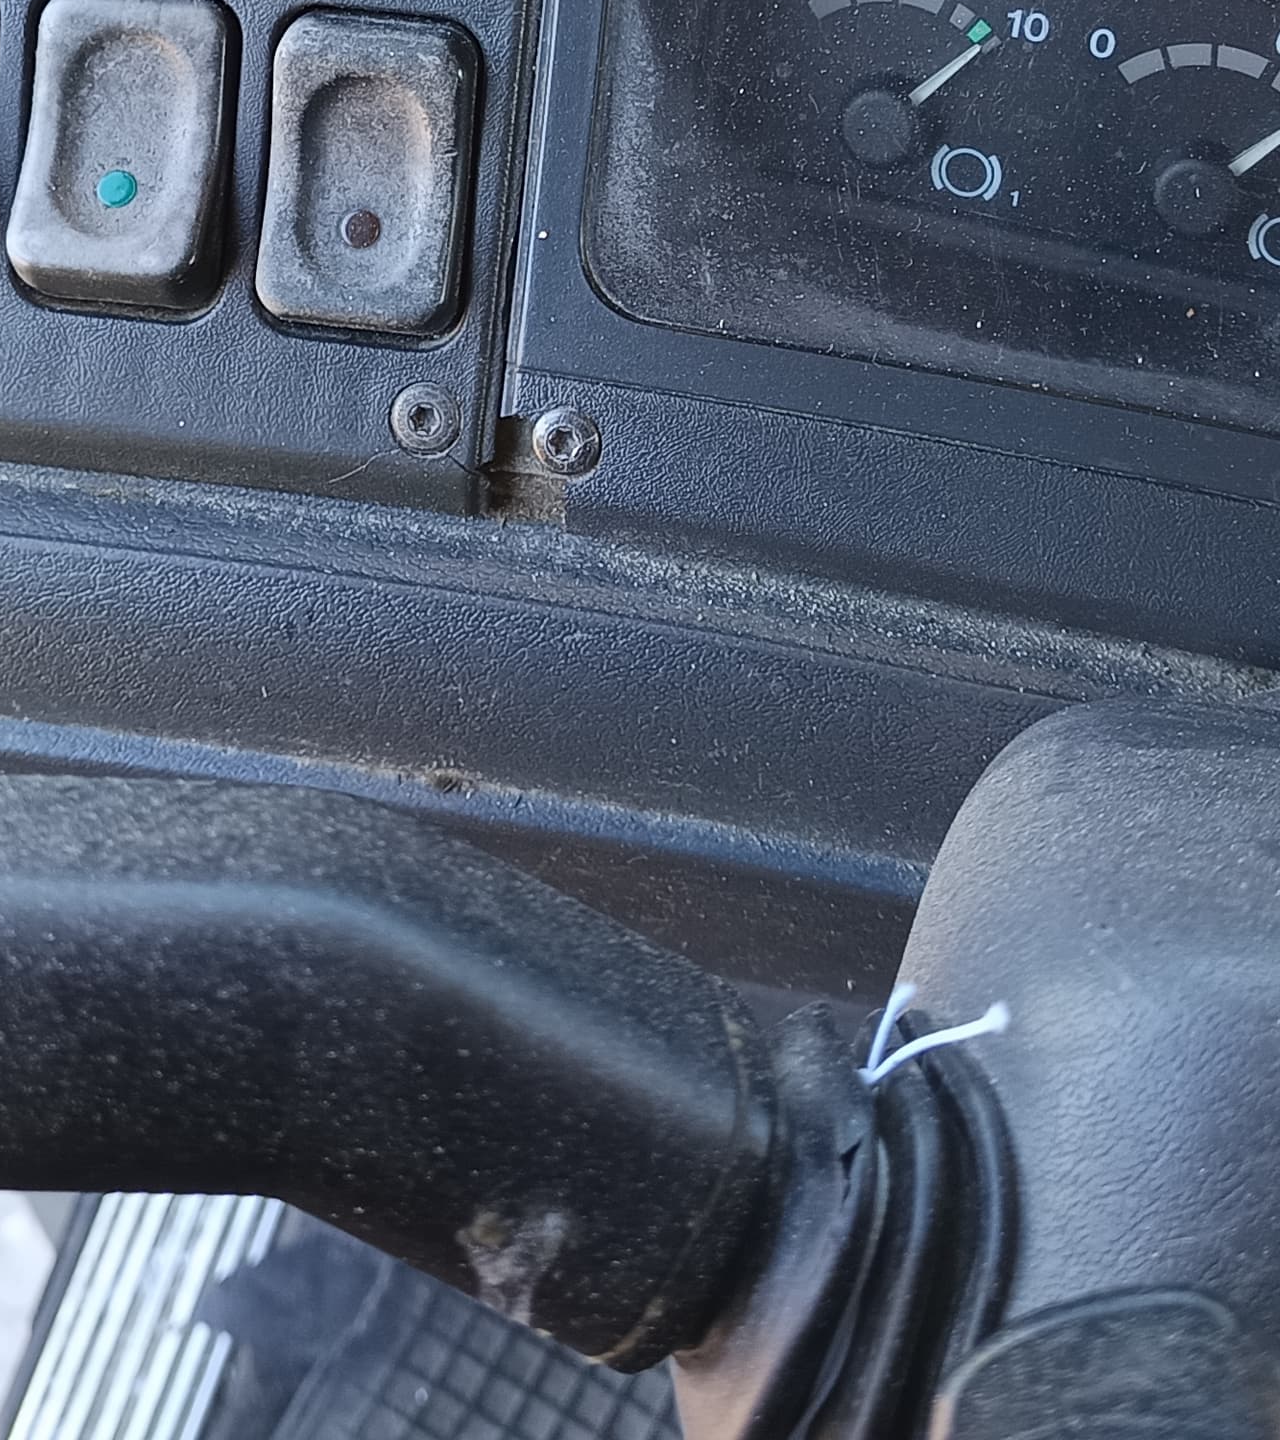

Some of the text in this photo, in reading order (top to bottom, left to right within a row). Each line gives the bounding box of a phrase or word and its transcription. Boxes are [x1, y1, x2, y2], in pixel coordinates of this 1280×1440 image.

[1006, 6, 1051, 43] 10
[1088, 27, 1117, 60] 0
[1009, 189, 1021, 208] 1
